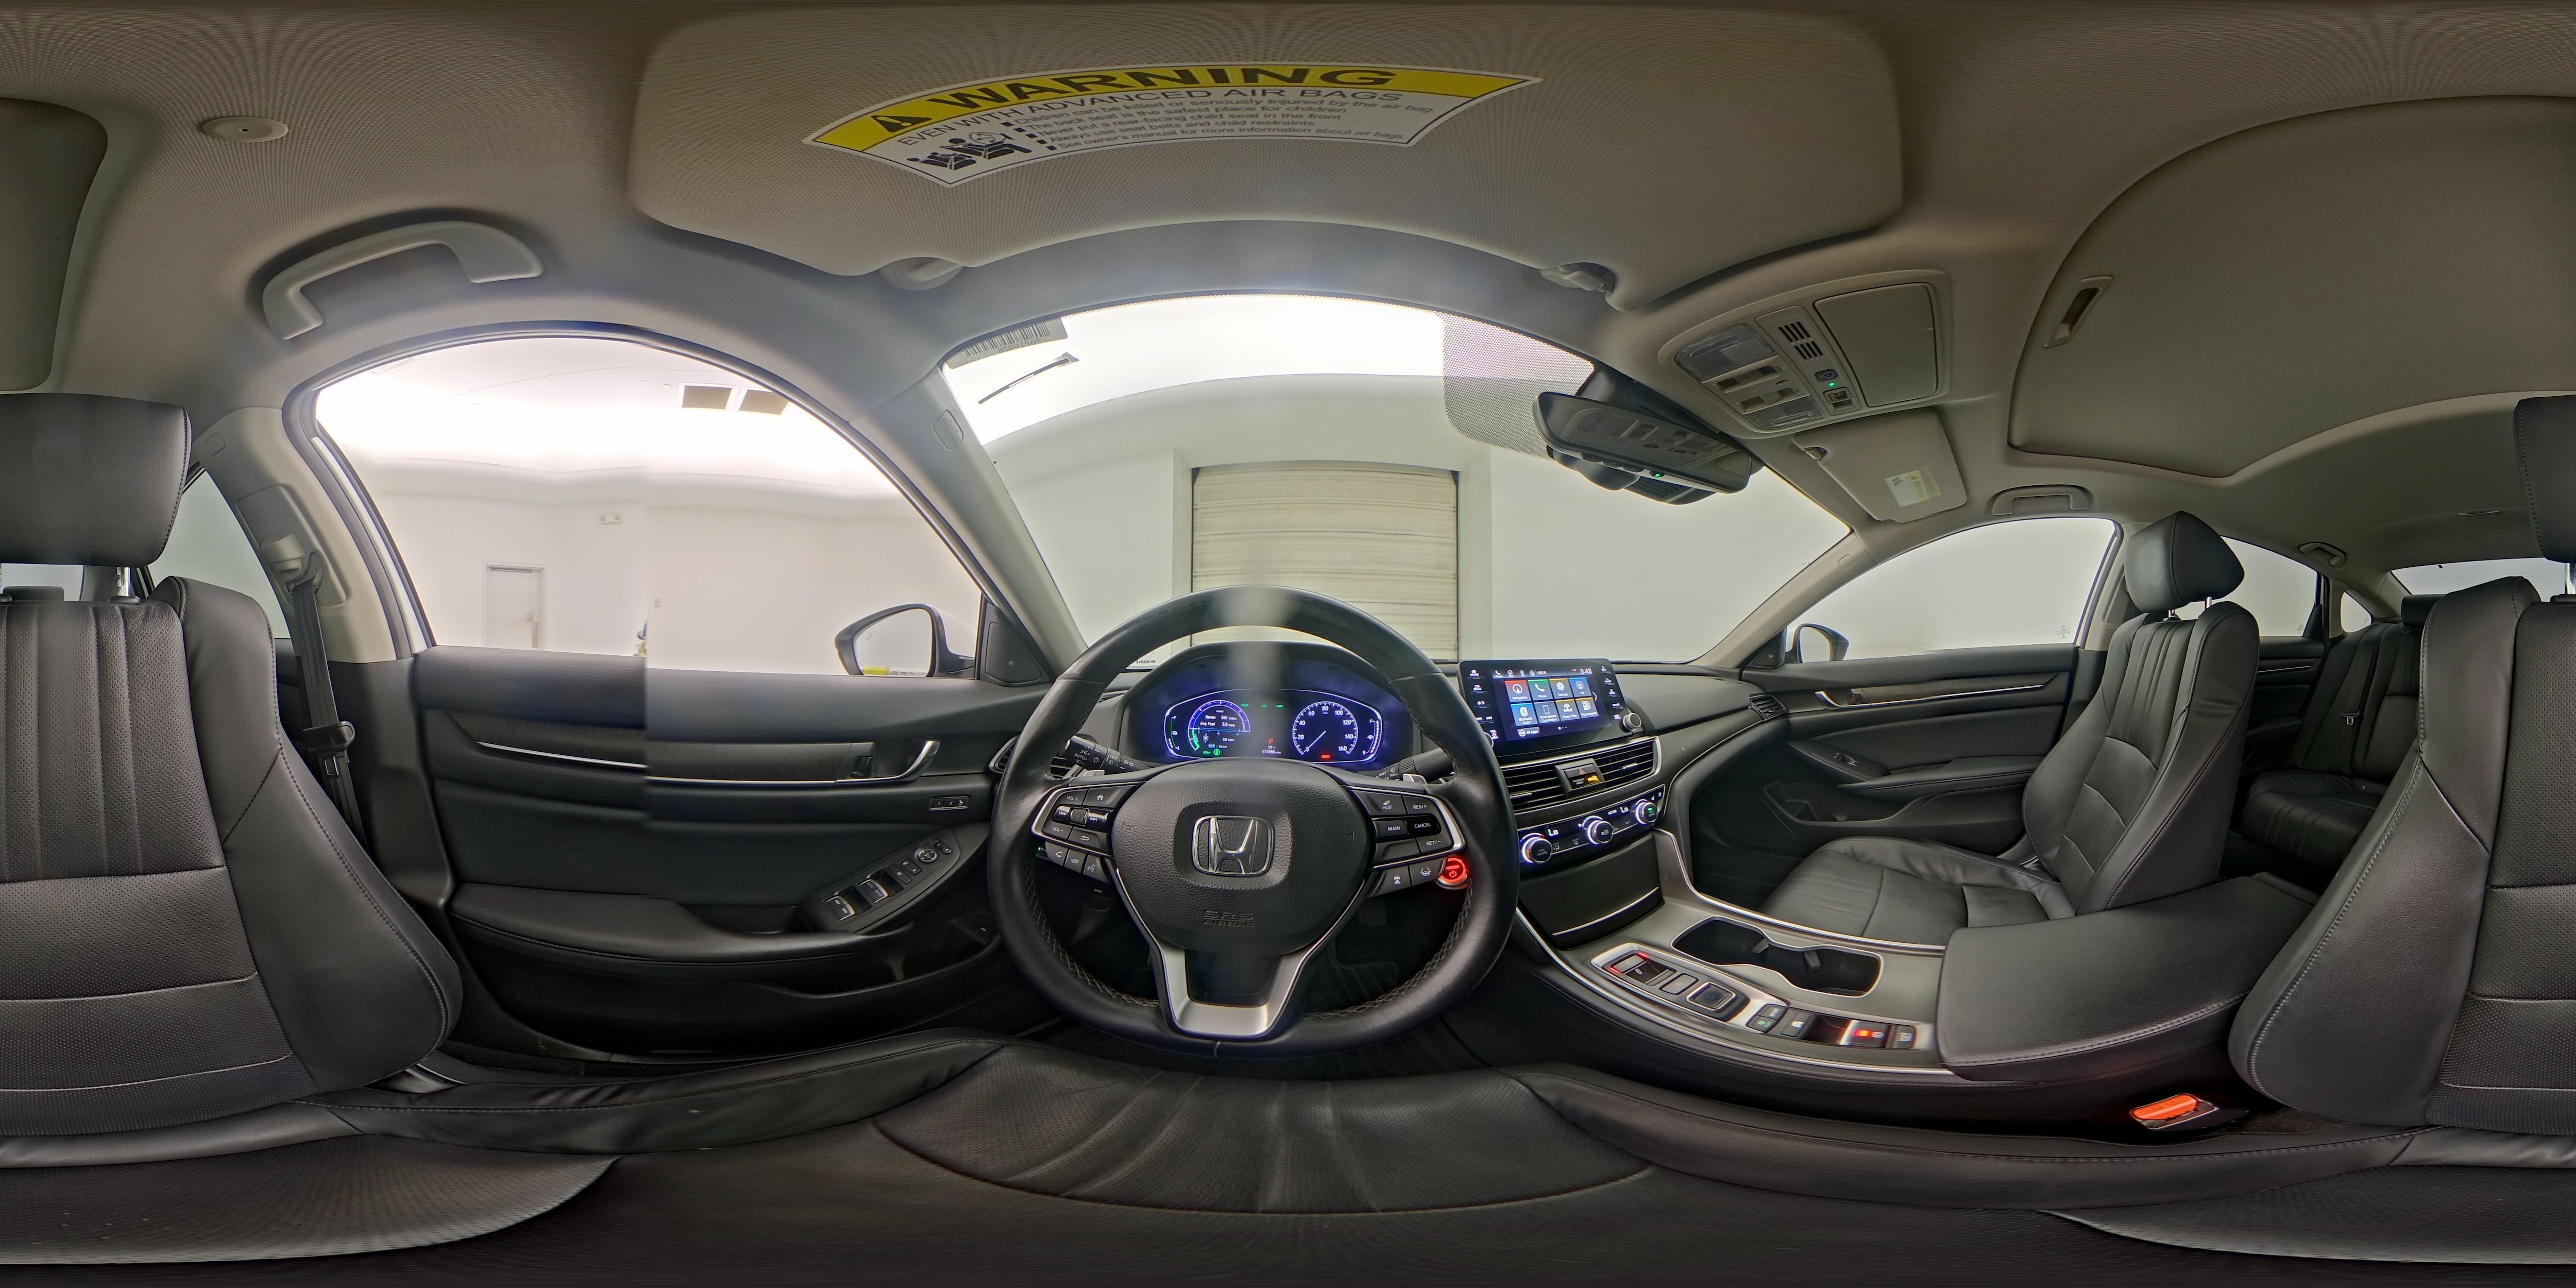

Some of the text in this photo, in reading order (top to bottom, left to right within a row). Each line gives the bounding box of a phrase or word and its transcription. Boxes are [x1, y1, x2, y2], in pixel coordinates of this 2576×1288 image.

[928, 67, 1397, 109] WARNING
[897, 124, 955, 145] EVEN
[953, 108, 1024, 127] WITH
[1028, 90, 1212, 113] ADVANCED
[1299, 90, 1403, 100] BAGS
[1014, 112, 1070, 124] Children
[1053, 117, 1087, 126] back
[1037, 127, 1075, 137] Never
[1112, 116, 1187, 126] rear-facing
[1050, 132, 1092, 142] Always
[1084, 135, 1129, 145] owner's
[1131, 130, 1178, 139] manual
